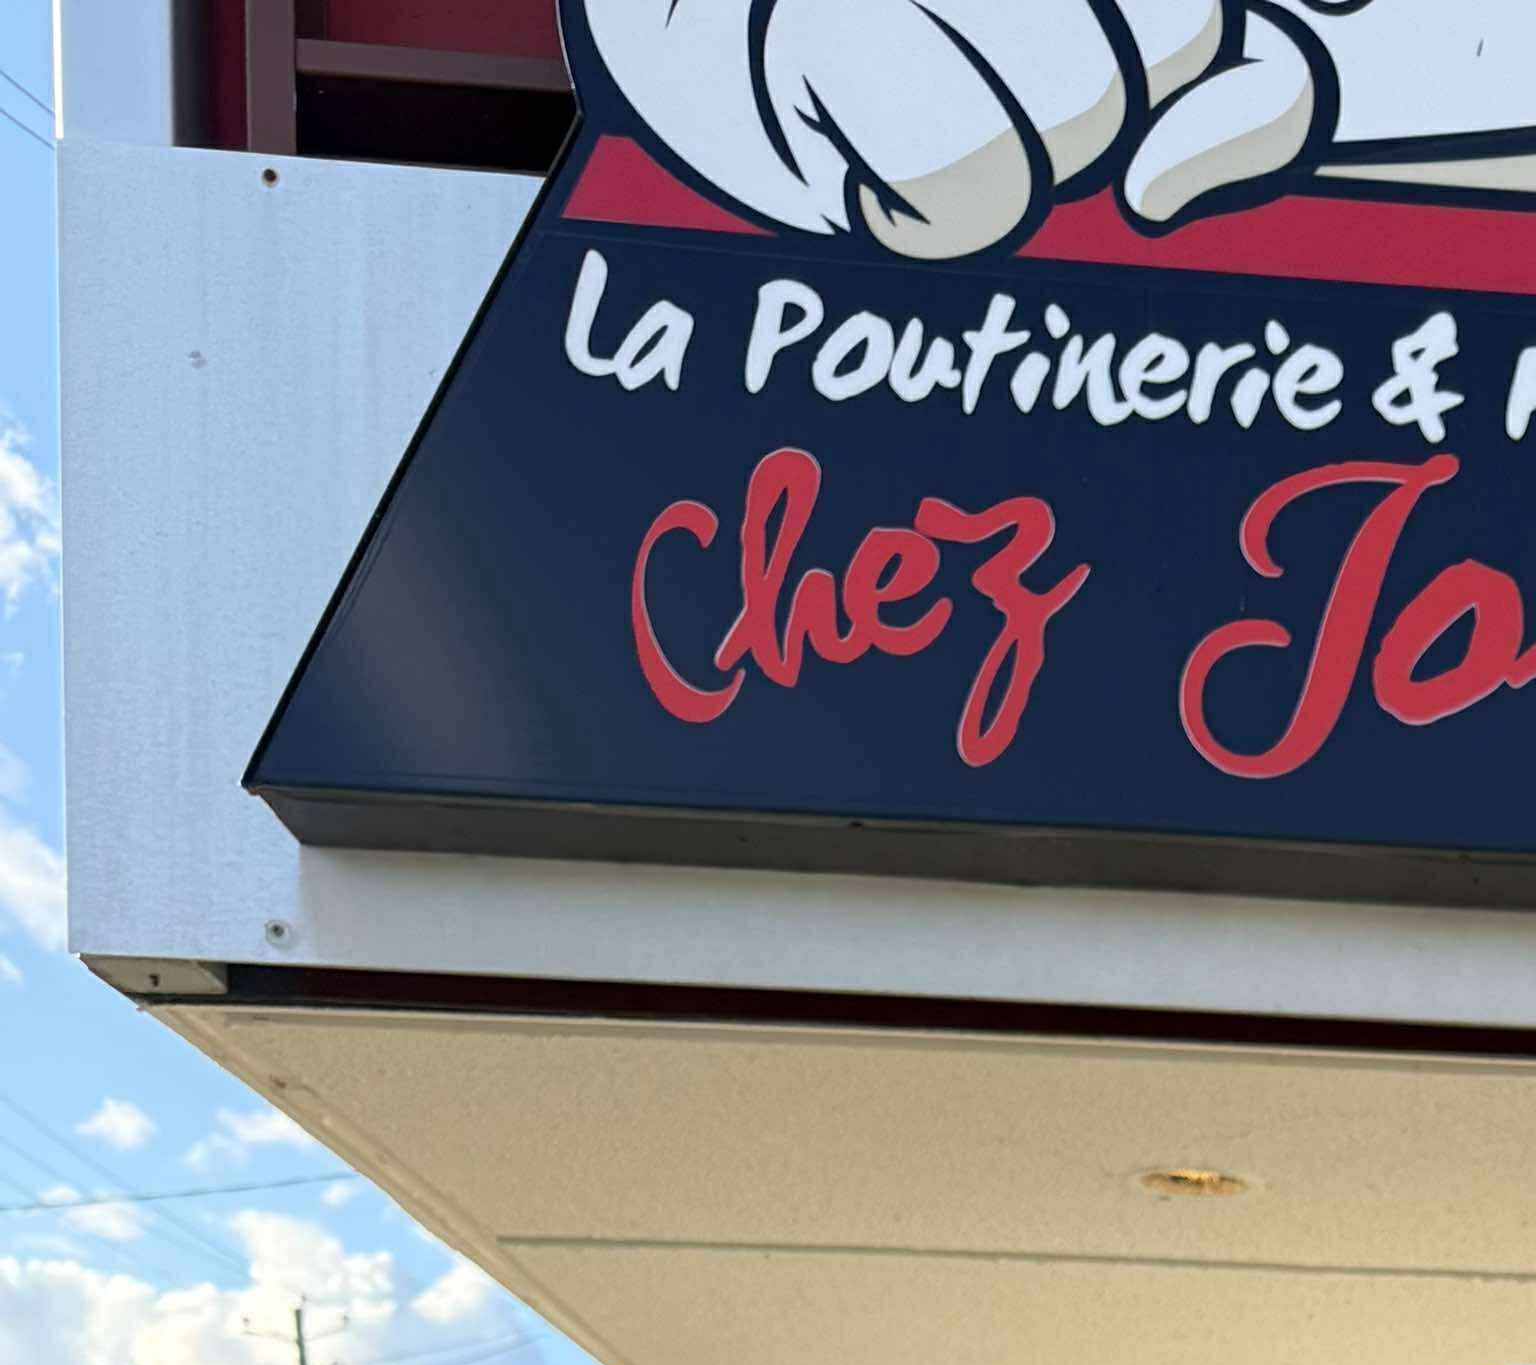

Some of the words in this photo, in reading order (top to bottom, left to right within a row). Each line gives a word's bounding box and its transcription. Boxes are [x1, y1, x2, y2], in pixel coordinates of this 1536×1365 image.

[564, 249, 694, 391] La
[745, 278, 1344, 430] Poutinerie
[1372, 311, 1465, 444] &
[629, 448, 1090, 767] Chez
